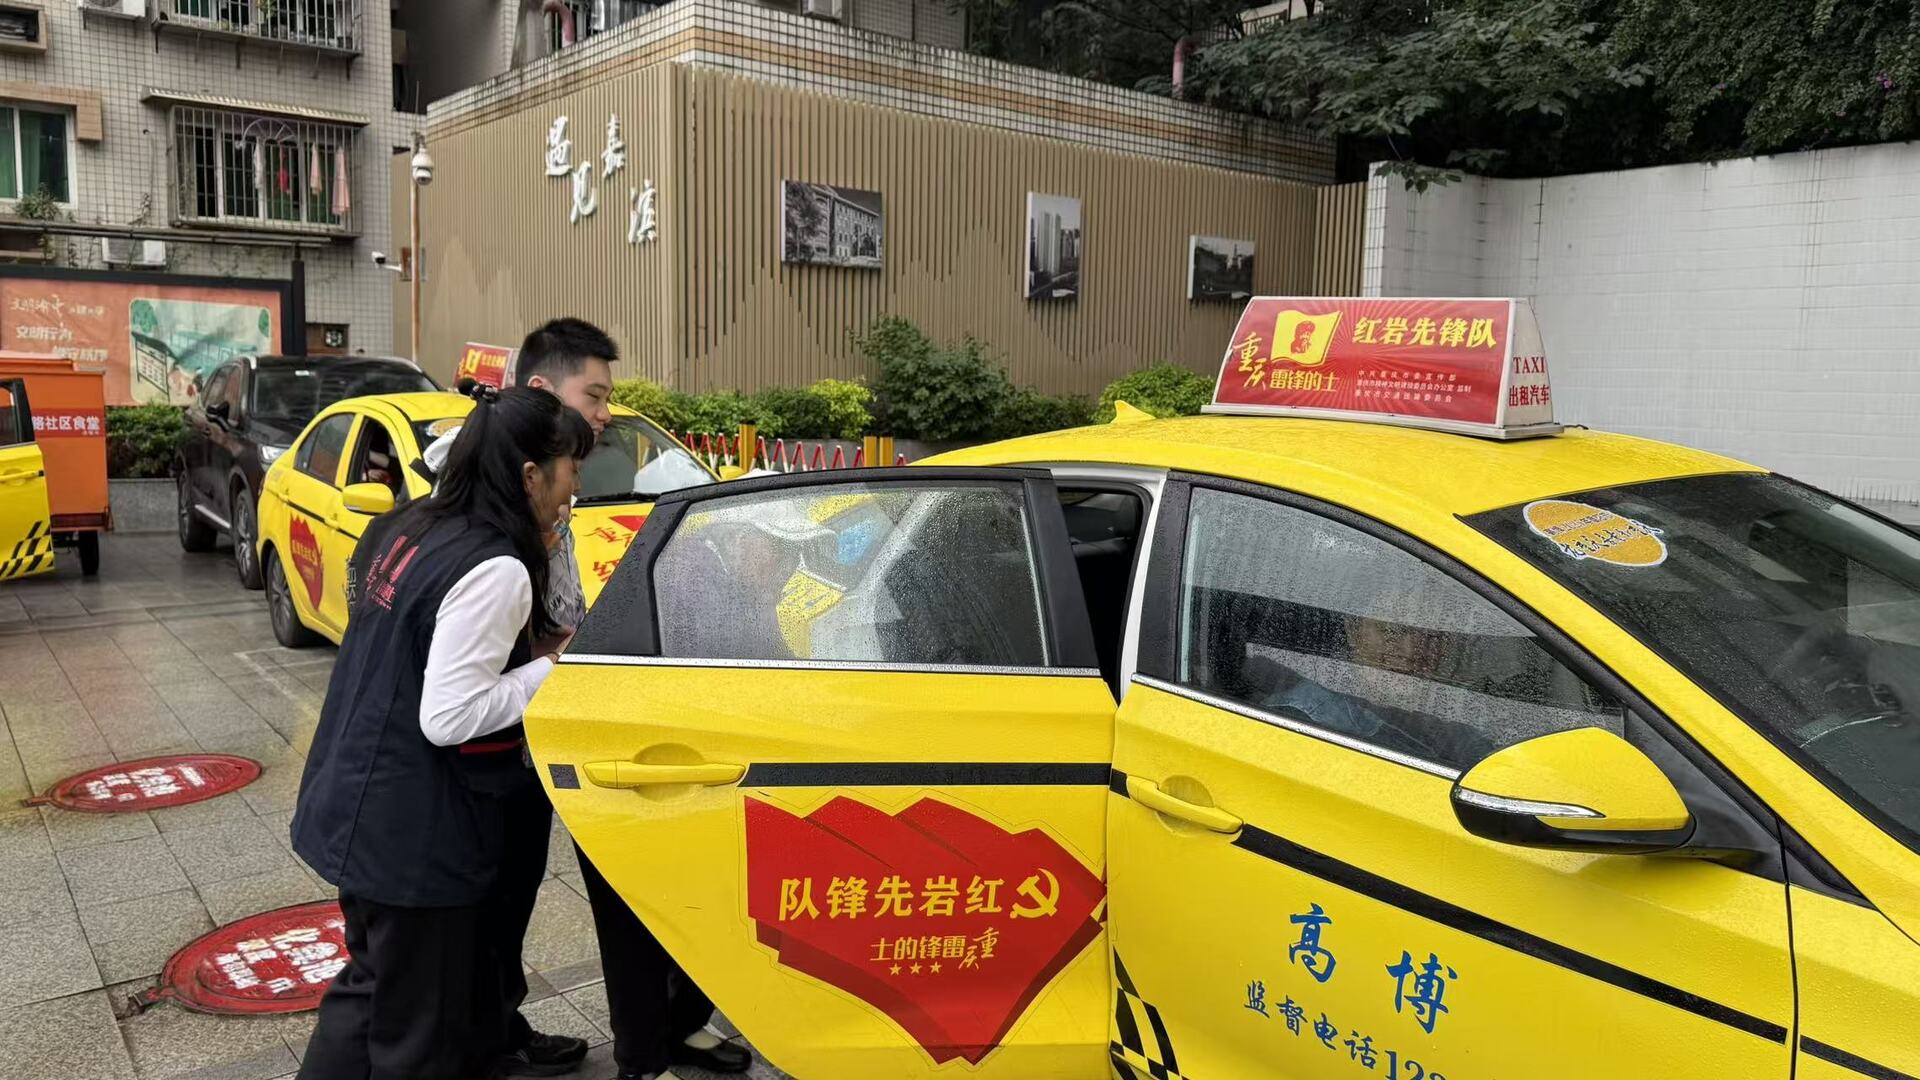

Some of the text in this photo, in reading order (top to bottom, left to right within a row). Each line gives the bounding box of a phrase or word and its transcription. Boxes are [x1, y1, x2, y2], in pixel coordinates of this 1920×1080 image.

[1352, 316, 1497, 348] 红岩先锋队
[1512, 356, 1546, 374] TAXI
[1269, 368, 1340, 393] 雷锋的士
[1508, 384, 1550, 407] 出租汽车
[1288, 902, 1459, 1034] 高博
[1243, 980, 1447, 1080] 监督电话12
